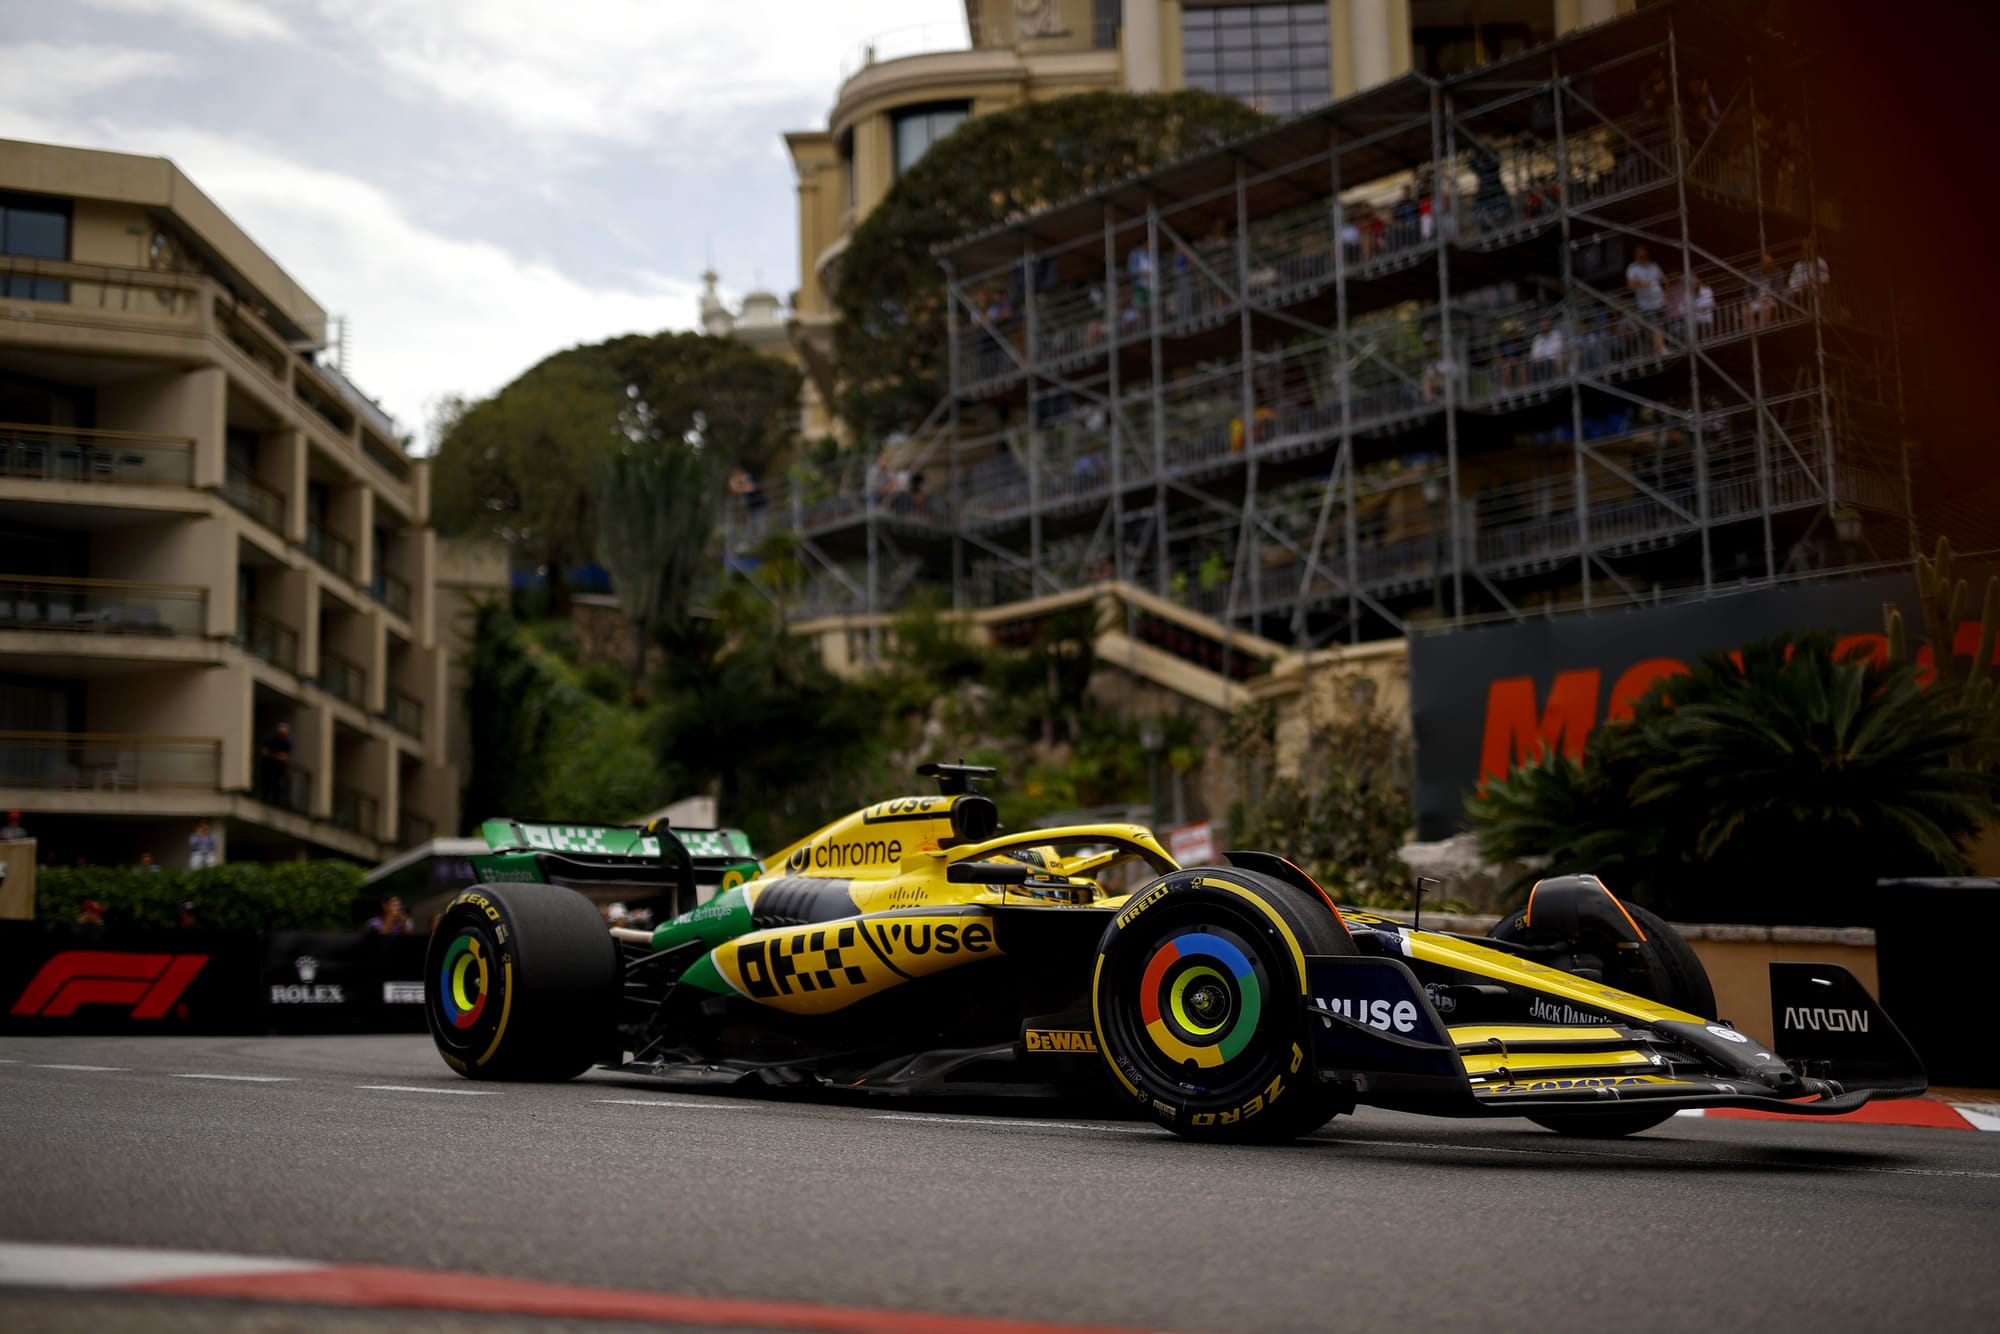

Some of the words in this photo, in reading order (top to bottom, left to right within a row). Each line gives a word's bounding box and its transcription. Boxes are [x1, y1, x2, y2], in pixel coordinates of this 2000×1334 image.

[815, 837, 903, 868] chrome
[1116, 882, 1169, 930] PIRELLI
[11, 950, 210, 1019] F1
[270, 984, 345, 1004] ROLEX
[1529, 996, 1562, 1024] JACK
[1784, 1006, 1869, 1033] ARROW
[1026, 1031, 1097, 1050] DEWAL
[1289, 1041, 1304, 1074] P
[1192, 1074, 1286, 1126] ZERO
